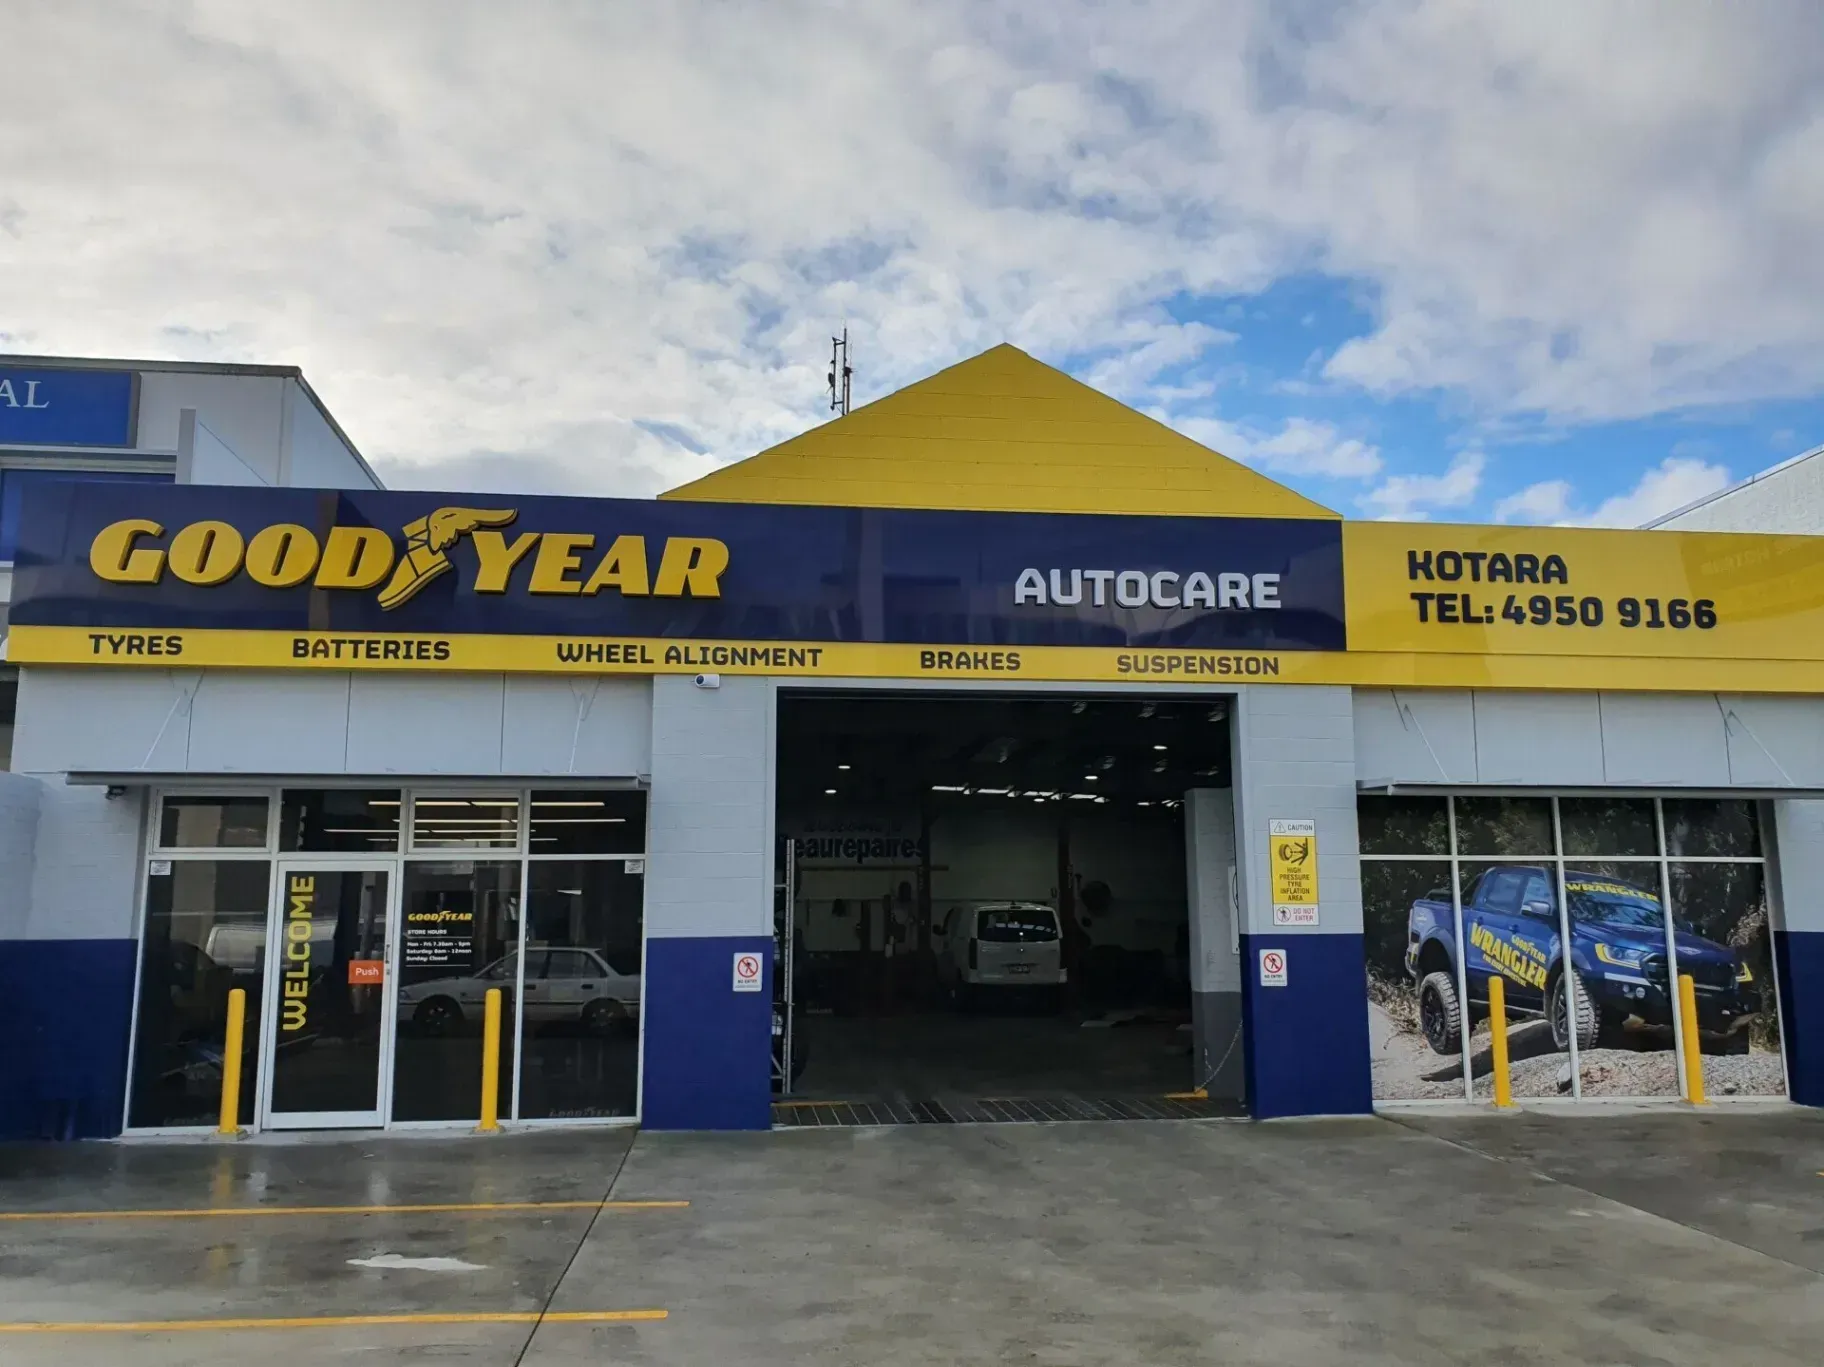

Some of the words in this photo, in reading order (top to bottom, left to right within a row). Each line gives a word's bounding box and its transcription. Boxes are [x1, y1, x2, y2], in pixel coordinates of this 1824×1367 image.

[1407, 549, 1569, 585] KOTARA
[1014, 567, 1282, 611] AUTOCARE
[1410, 592, 1495, 625] TEL:
[1501, 594, 1604, 627] 4950
[1616, 597, 1718, 630] 9166
[88, 634, 183, 656] TYRES
[292, 638, 451, 661] BATTERIES
[556, 642, 655, 664] WHEEL
[664, 645, 823, 669] ALIGNMENT
[920, 650, 1021, 671] BRAKES
[1116, 654, 1280, 676] SUSPENSION
[782, 837, 924, 864] eaurepaires
[282, 876, 315, 1031] WELCOME
[1470, 922, 1548, 991] WRANGLER
[355, 967, 379, 976] Push
